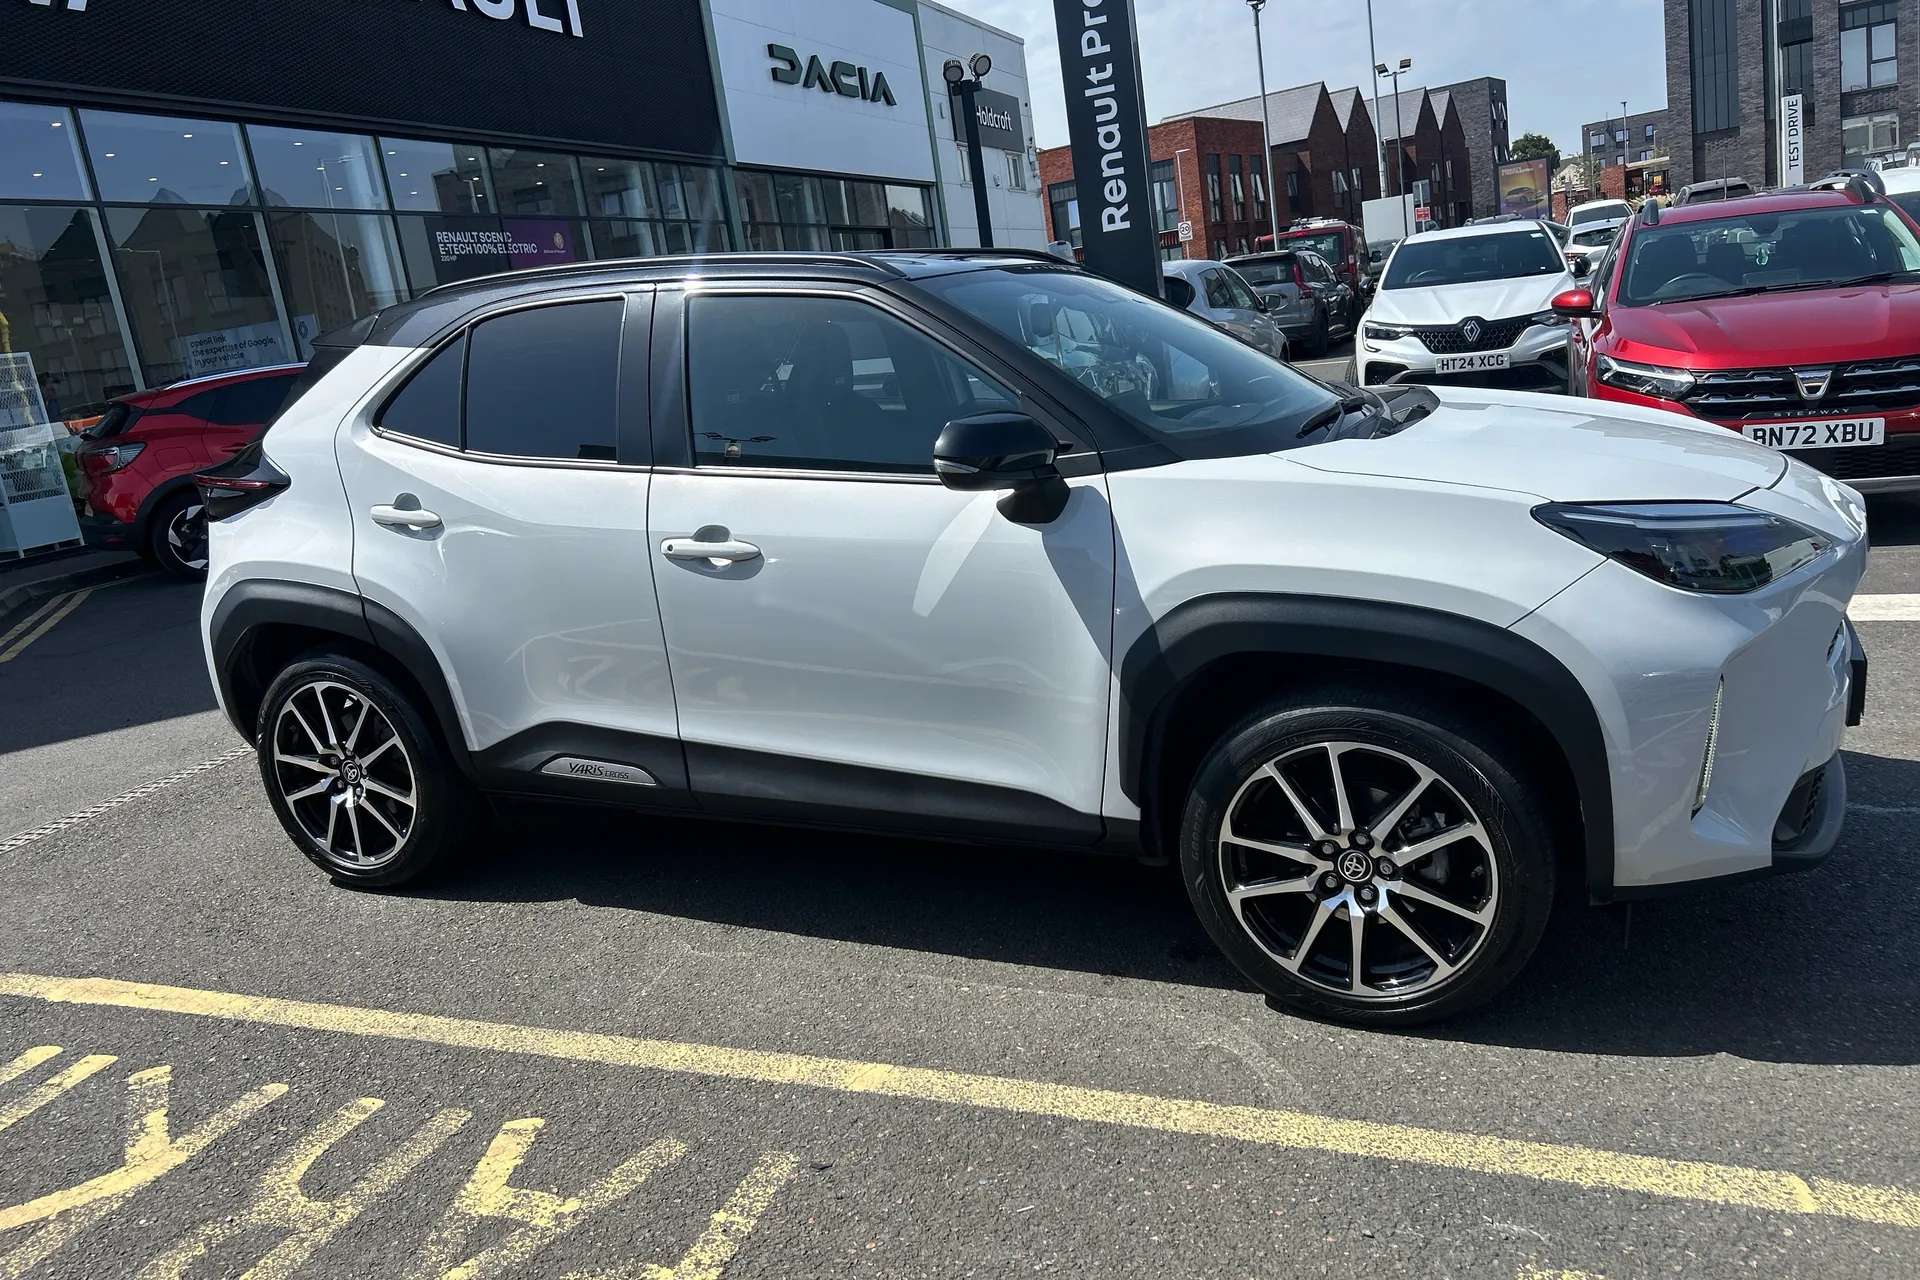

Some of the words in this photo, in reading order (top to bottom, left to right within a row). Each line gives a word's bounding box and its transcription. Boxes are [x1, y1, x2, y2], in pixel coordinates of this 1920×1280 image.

[767, 43, 897, 106] DACIA
[1787, 98, 1798, 137] DRIVE
[1085, 63, 1131, 232] Renault
[1788, 140, 1799, 170] TEST
[436, 231, 479, 243] RENAULT
[439, 243, 474, 255] E-TECH
[474, 243, 497, 255] 100%
[498, 243, 538, 254] ELECTRIC
[1441, 357, 1474, 371] HT24
[1479, 354, 1504, 368] XCG
[1774, 408, 1849, 417] STEPWAY
[1752, 425, 1817, 447] BN72
[1824, 421, 1874, 444] XBU
